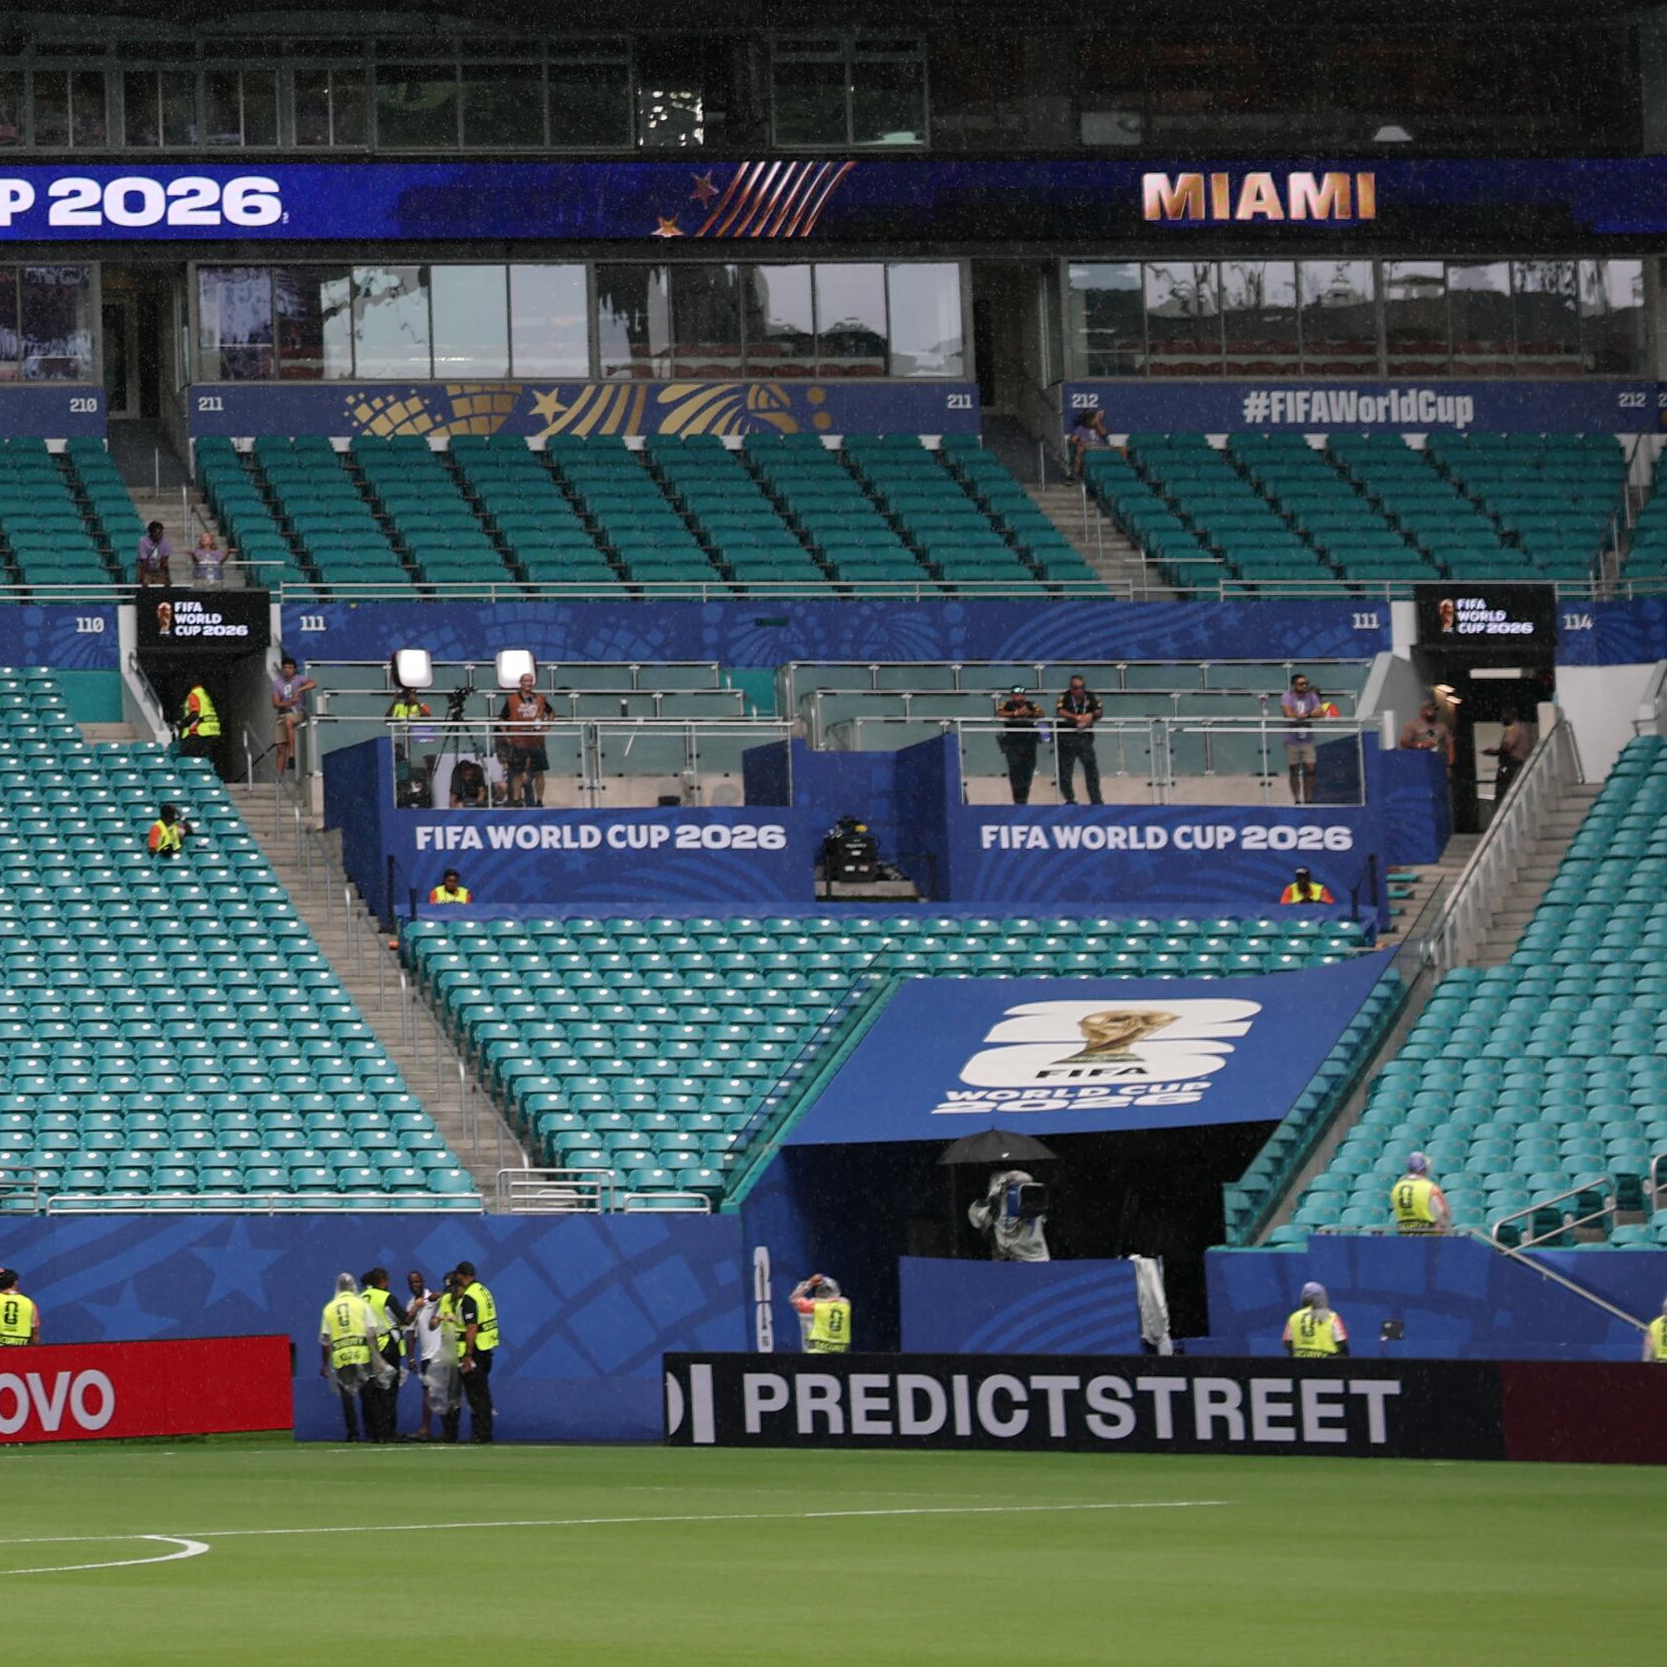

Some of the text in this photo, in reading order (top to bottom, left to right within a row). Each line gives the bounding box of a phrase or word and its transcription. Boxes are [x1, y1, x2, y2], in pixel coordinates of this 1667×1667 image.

[49, 177, 281, 226] 2026
[1142, 171, 1375, 220] MIAMI
[69, 397, 98, 413] 210
[198, 396, 224, 412] 211
[947, 393, 973, 409] 211
[1071, 393, 1099, 409] 212
[1618, 392, 1646, 408] 212
[1243, 389, 1473, 428] #FIFAWorldCup
[174, 601, 203, 613] FIFA
[1456, 598, 1488, 610] FIFA
[174, 613, 223, 625] WORLD
[299, 615, 327, 632] 111
[1352, 612, 1380, 630] 111
[1457, 610, 1507, 623] WORLD
[76, 617, 105, 633] 110
[174, 624, 249, 636] CUP 2026
[1457, 622, 1534, 634] CUP 2026
[415, 824, 787, 850] FIFA WORLD CUP 2026
[981, 825, 1353, 851] FIFA WORLD CUP 2026
[1034, 1065, 1150, 1080] FIFA
[946, 1080, 1213, 1103] WORLD CUP
[931, 1092, 1204, 1115] 2026
[744, 1374, 1400, 1443] PREDICTSTREET
